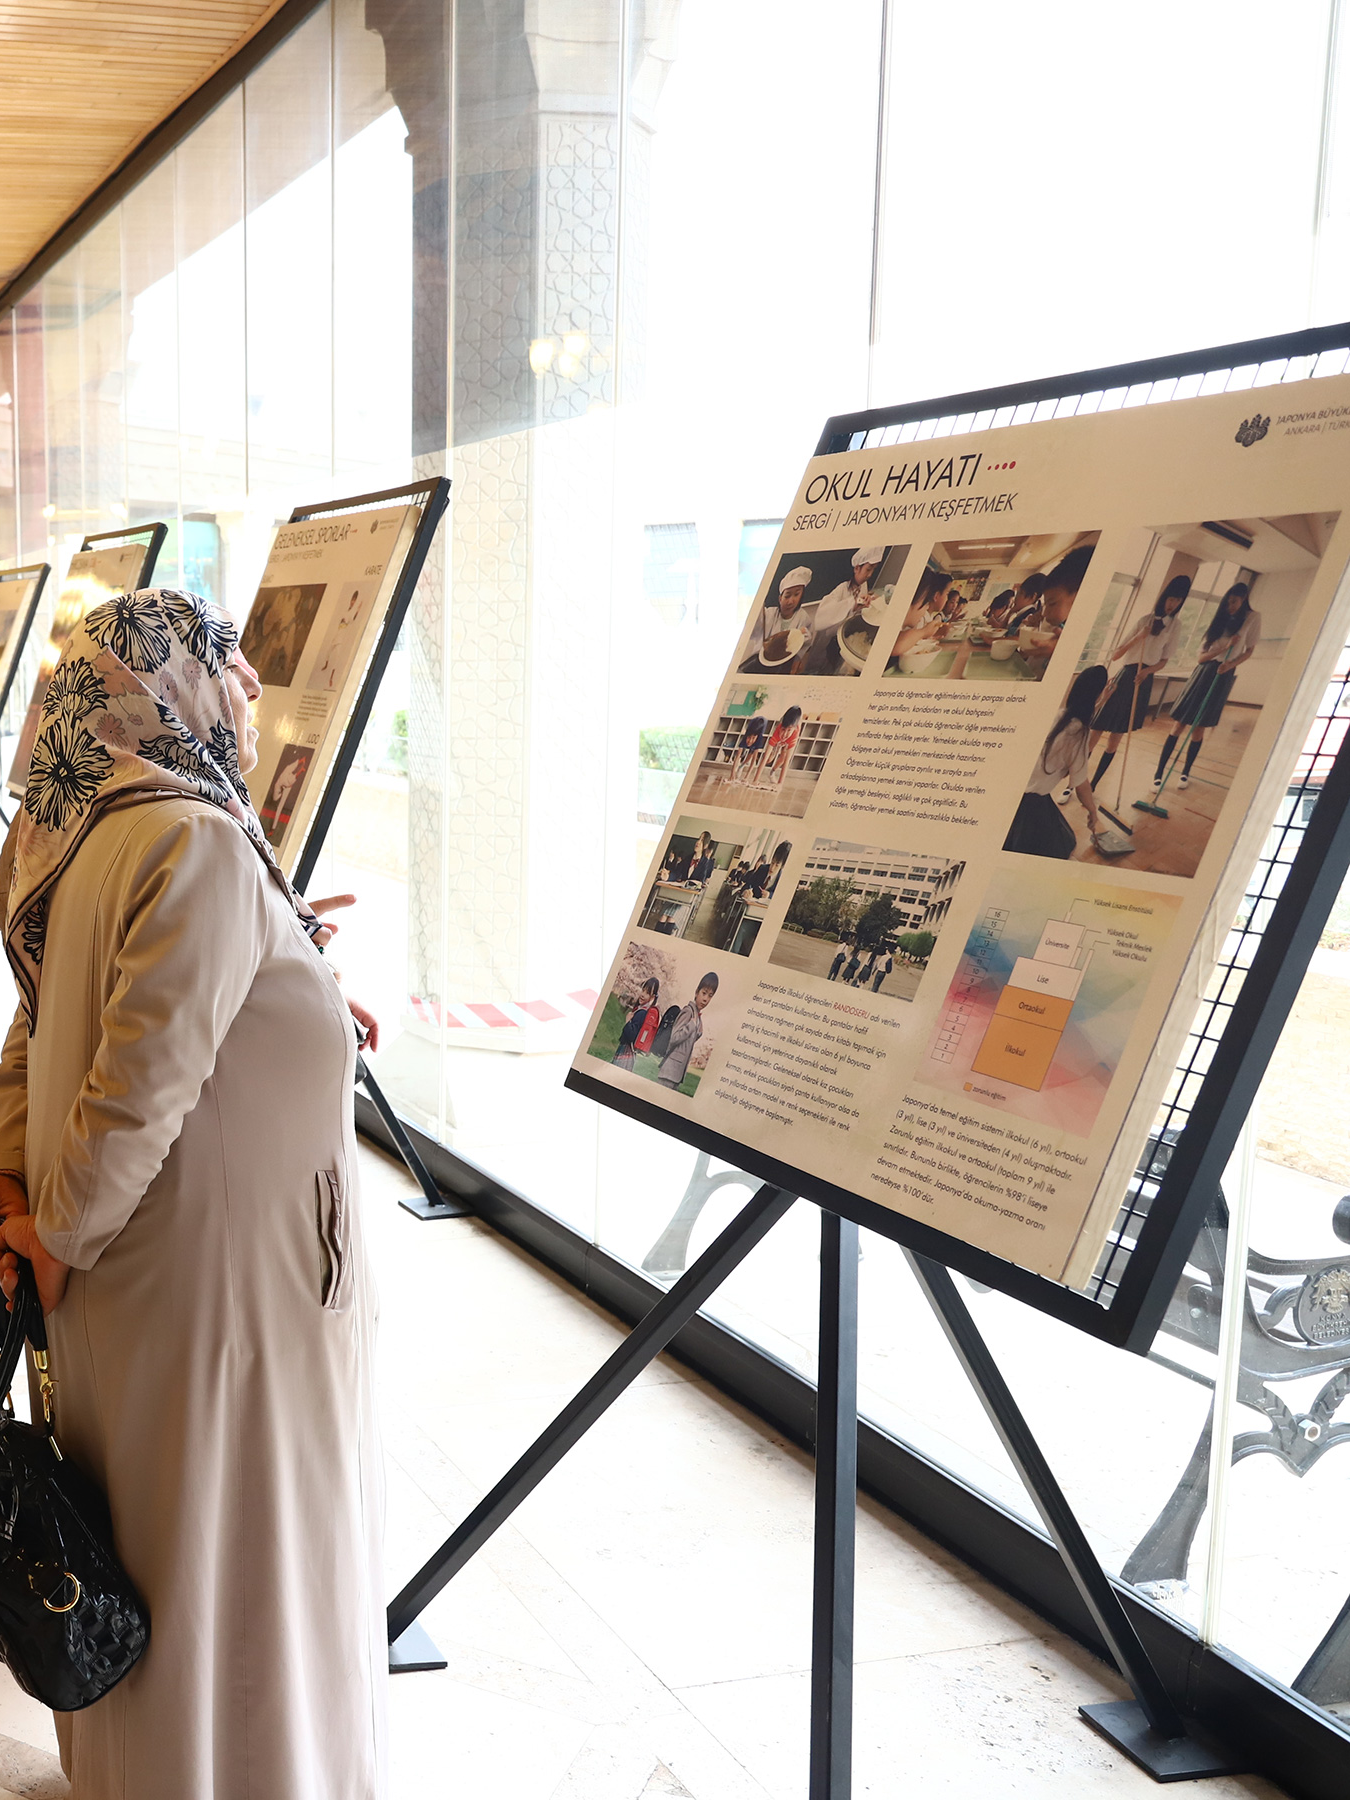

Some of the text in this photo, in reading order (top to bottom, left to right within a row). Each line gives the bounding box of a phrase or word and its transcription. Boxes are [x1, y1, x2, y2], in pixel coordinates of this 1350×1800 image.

[1317, 406, 1350, 419] BÜYÜK
[805, 453, 983, 505] OKUL HAYATI
[793, 492, 1019, 532] SERGİ JAPONYA'YI KEŞFETMEK
[867, 703, 878, 711] her
[876, 703, 889, 713] gün
[950, 706, 966, 715] okul
[964, 707, 996, 718] bahçesini
[873, 689, 1027, 704] Japonya'da öğrenciler eğitimlerinin bir parçası olarak
[856, 730, 882, 739] sınıflarda
[881, 731, 893, 742] hep
[893, 732, 913, 742] birlikte
[932, 735, 959, 745] Yemekler
[959, 737, 981, 747] okulda
[982, 741, 997, 749] veya
[891, 718, 902, 726] Pek
[901, 719, 913, 729] çok
[913, 719, 934, 729] okulda
[933, 721, 965, 731] öğrenciler
[964, 722, 979, 733] öğle
[978, 724, 1017, 733] yemeklerini
[834, 785, 847, 795] öğle
[846, 788, 868, 798] yemeği
[891, 792, 913, 803] sağlıklı
[920, 795, 932, 805] çok
[958, 799, 968, 809] Bu
[849, 802, 878, 812] öğrenciler
[876, 806, 896, 815] yemek
[896, 808, 917, 817] saatini
[915, 810, 951, 822] sabırsızlıkla
[1036, 975, 1050, 984] Lise
[757, 979, 787, 995] Japonya'da
[786, 988, 805, 1000] ilkokul
[832, 1001, 871, 1020] RANDOSERU
[869, 1014, 880, 1022] adı
[881, 1018, 901, 1029] verilen
[1018, 1001, 1046, 1015] Ortaokul
[821, 1014, 831, 1024] Bu
[829, 1019, 854, 1031] çantalar
[853, 1024, 869, 1035] hafif
[740, 1022, 755, 1033] geniş
[755, 1024, 761, 1035] iç
[760, 1026, 780, 1039] hacimli
[786, 1035, 805, 1047] ilkokul
[803, 1042, 821, 1053] süresi
[819, 1047, 834, 1058] olan
[833, 1051, 839, 1060] 6
[837, 1053, 848, 1063] yıl
[845, 1054, 871, 1071] boyunca
[743, 1068, 758, 1079] erkek
[780, 1082, 795, 1093] siyah
[794, 1088, 811, 1099] çanta
[810, 1092, 839, 1109] kullanıyor
[837, 1104, 851, 1115] olsa
[850, 1108, 860, 1118] da
[895, 1109, 1073, 1182] (3 yıl), lise (3 yıl) ve üniversiteden (4 yıl) oluşmaktadır.
[901, 1094, 1088, 1165] Japonya'da temel eğitim sistemi ilkokul (6 yıl), ortaokul
[889, 1124, 1056, 1195] Zorunlu eğitim ilkokul ve ortaokul (toplam 9 yıl) ile
[870, 1172, 935, 1206] neredeyse %100'dür.
[876, 1155, 1046, 1231] devam etmektedir. Japonya'da okuma-yazma oranı
[883, 1142, 1048, 1212] sınırlıdır. Bununla birlikte, öğrencilerin %98'i liseye
